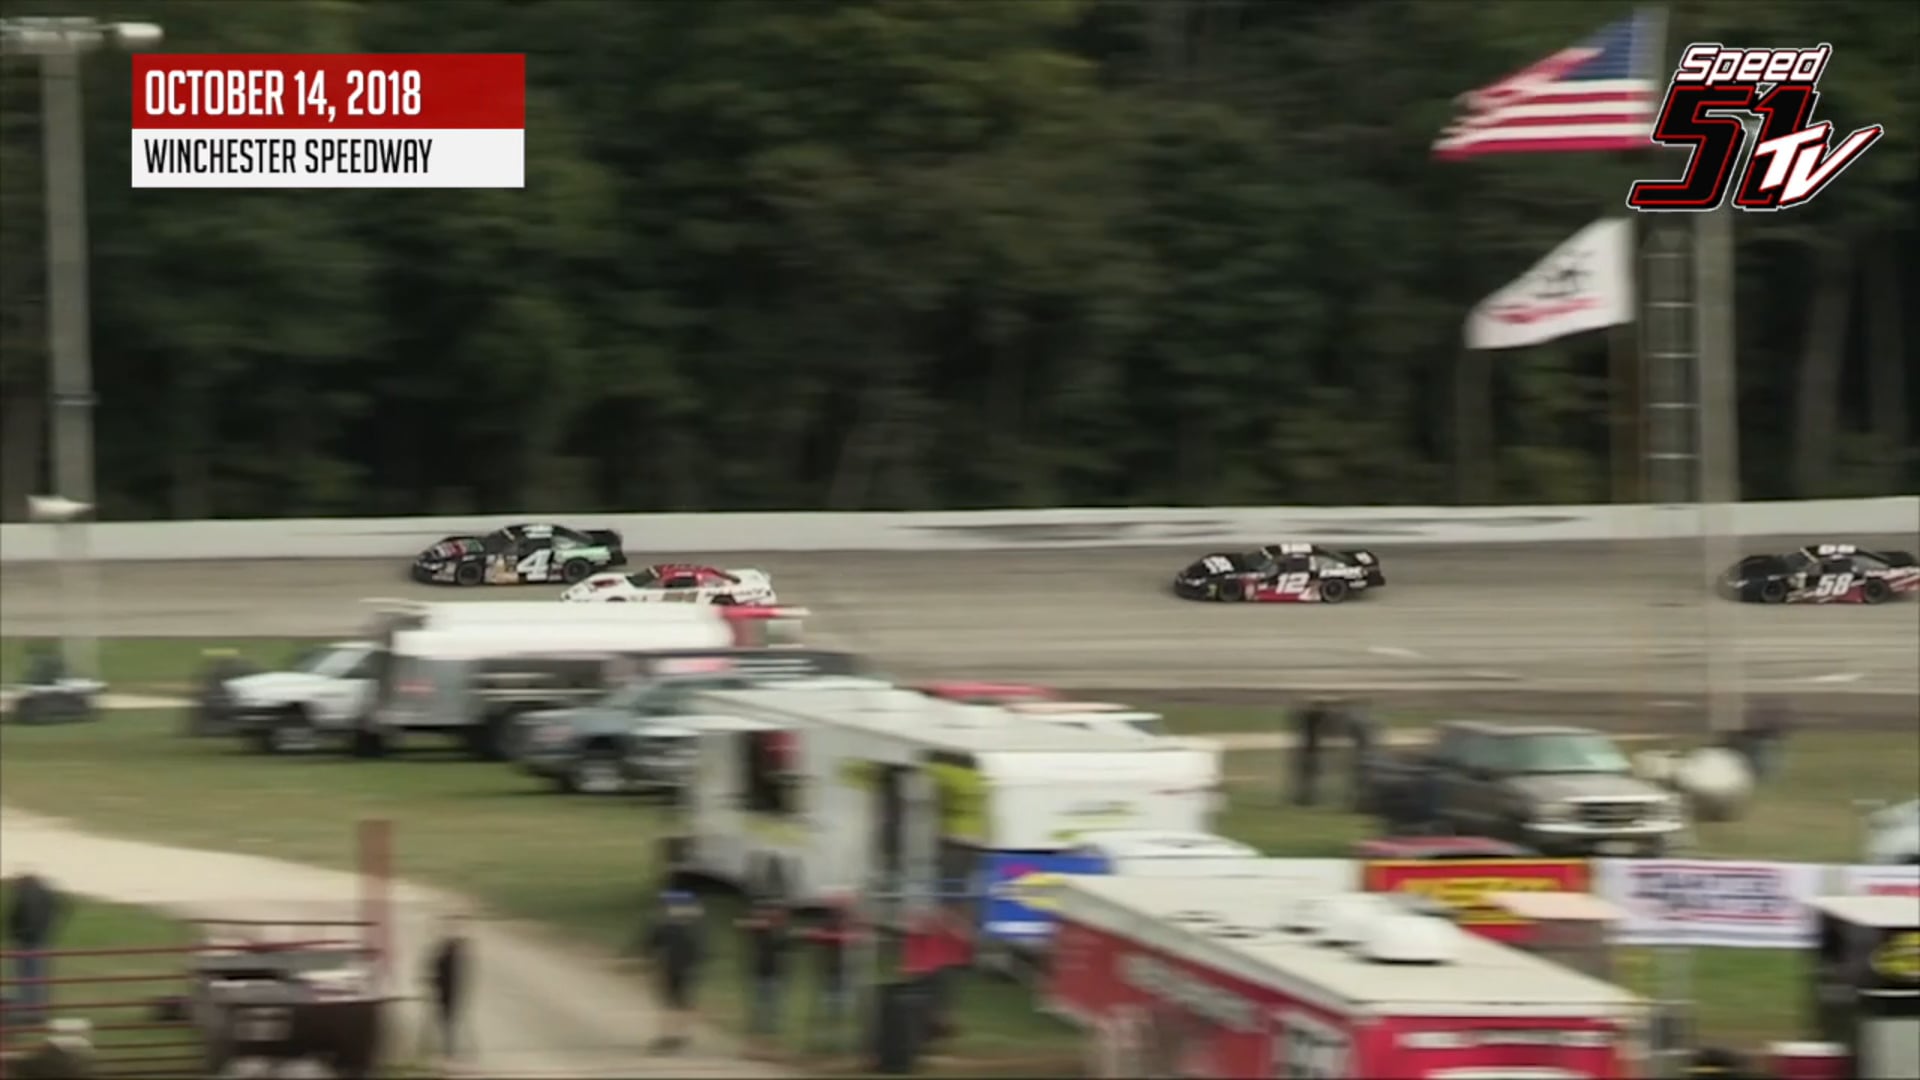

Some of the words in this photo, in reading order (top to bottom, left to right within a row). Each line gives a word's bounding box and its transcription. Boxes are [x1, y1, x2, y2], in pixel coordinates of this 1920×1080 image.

[517, 548, 551, 581] 4
[1276, 572, 1310, 594] 12
[1816, 572, 1853, 596] 58
